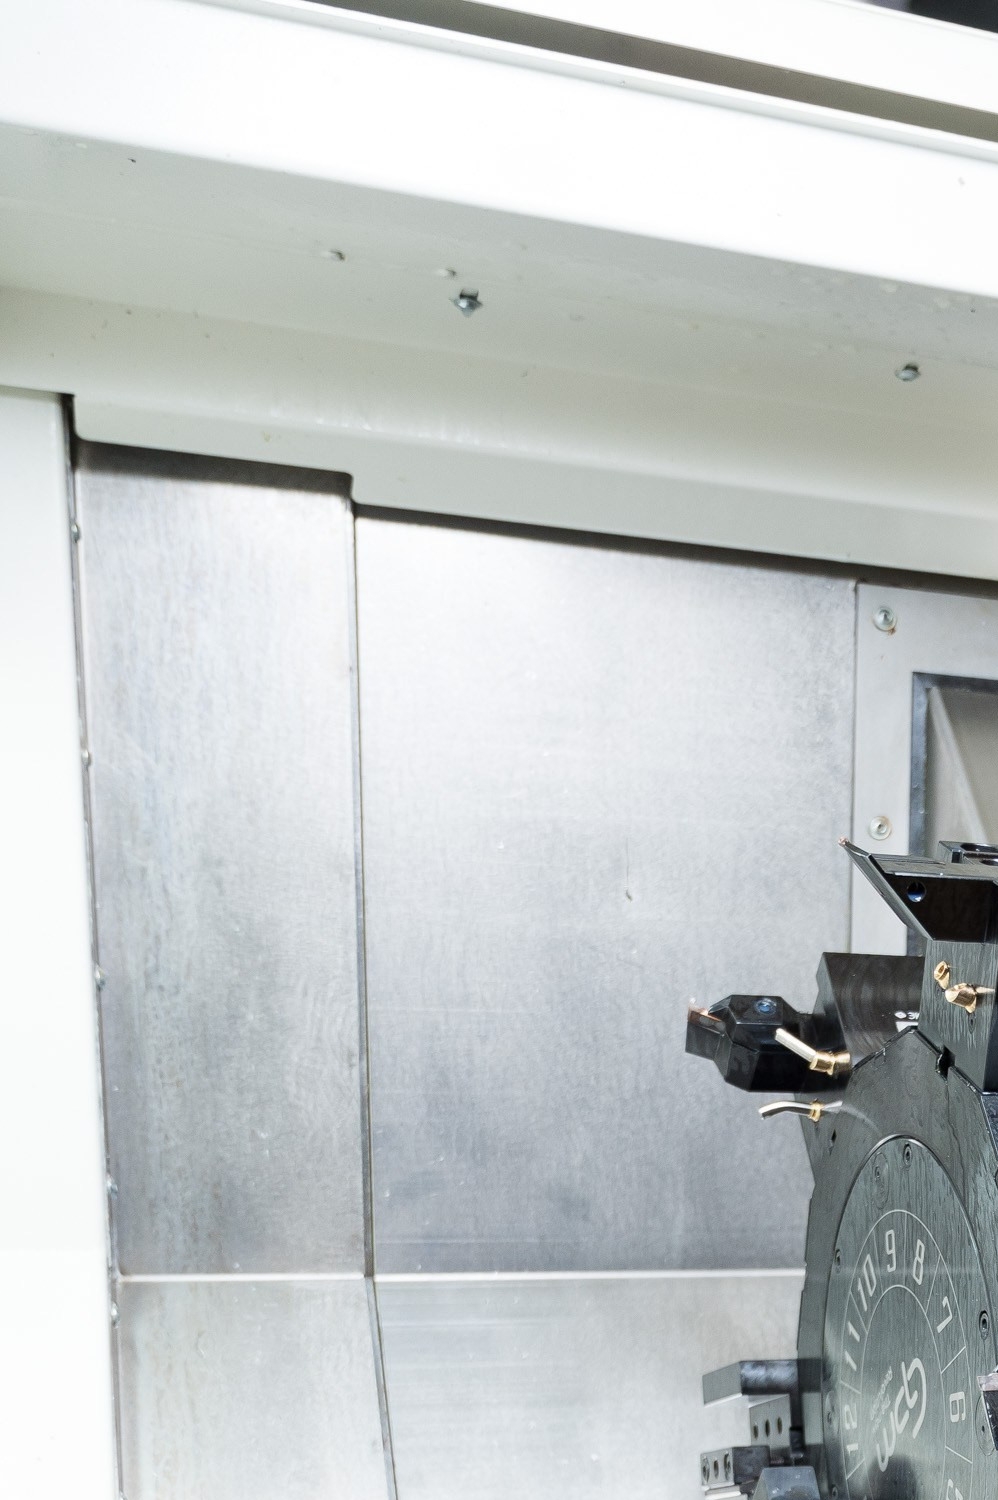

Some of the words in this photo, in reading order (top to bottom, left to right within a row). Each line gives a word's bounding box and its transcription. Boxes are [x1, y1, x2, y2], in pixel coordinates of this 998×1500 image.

[885, 1229, 897, 1273] 9
[912, 1239, 925, 1285] 8
[857, 1253, 877, 1312] 10
[936, 1296, 953, 1334] 7
[844, 1321, 860, 1372] 11
[844, 1403, 859, 1456] 12
[949, 1391, 966, 1423] 6
